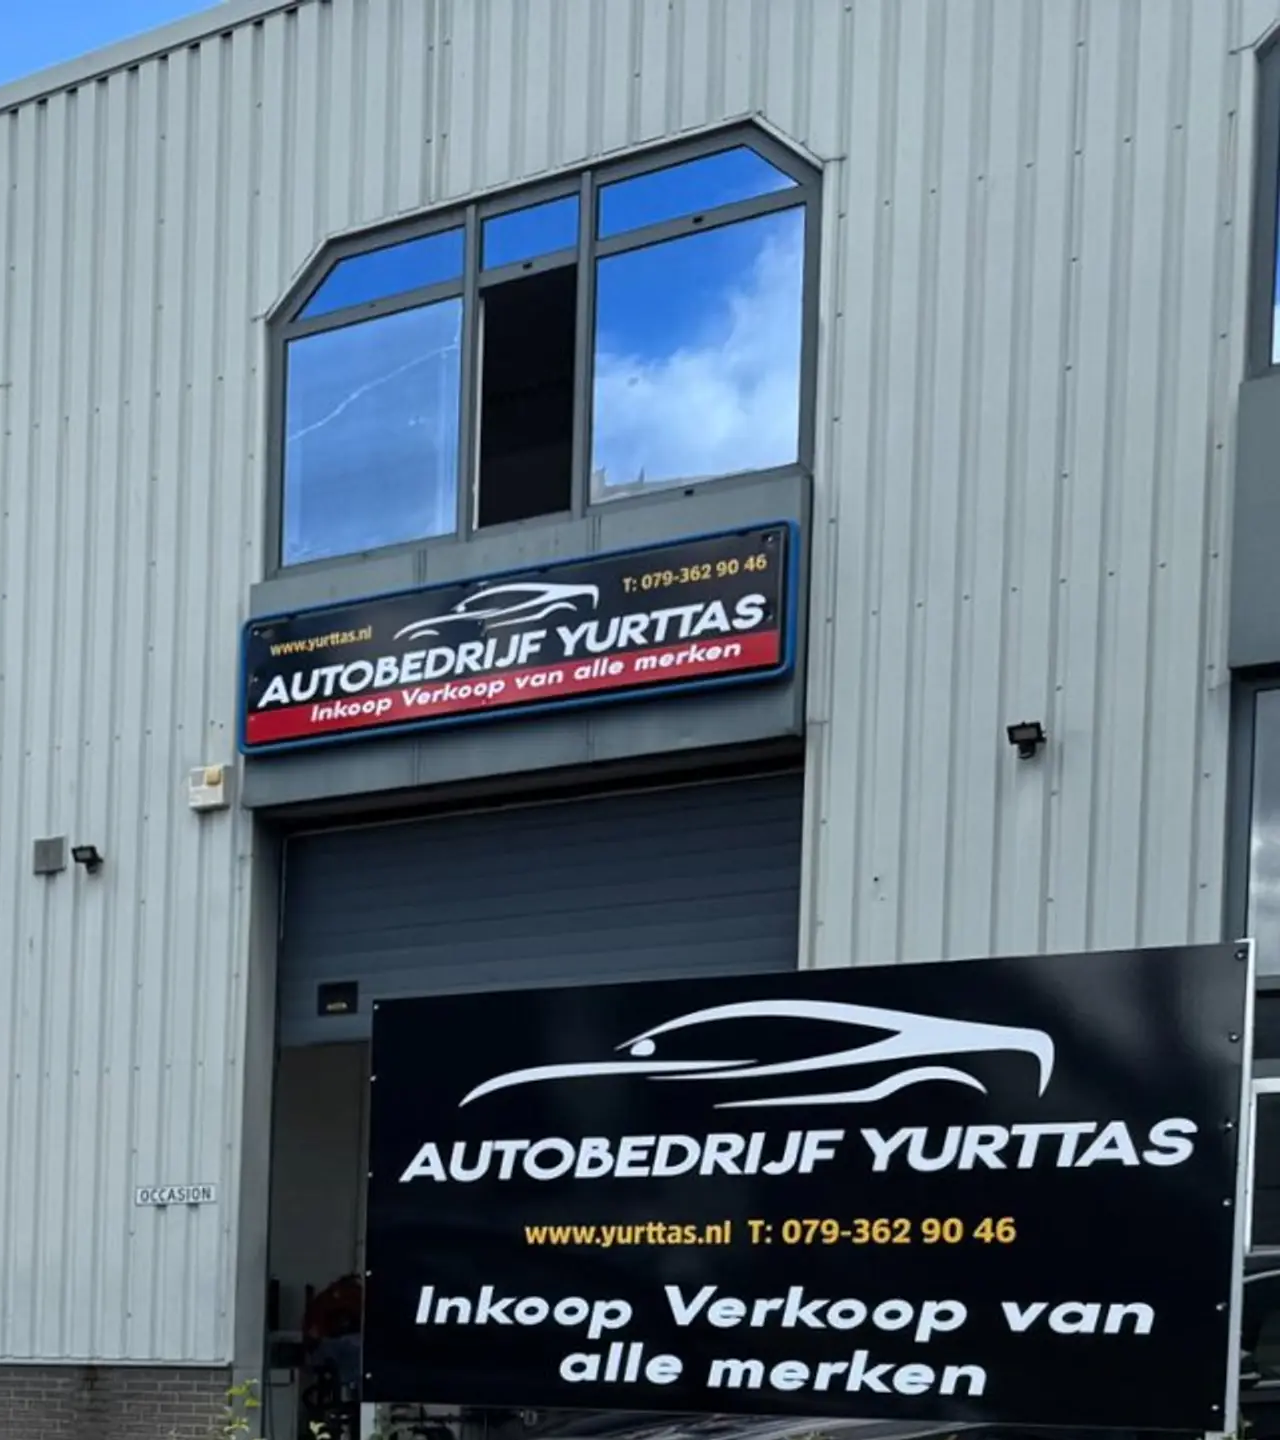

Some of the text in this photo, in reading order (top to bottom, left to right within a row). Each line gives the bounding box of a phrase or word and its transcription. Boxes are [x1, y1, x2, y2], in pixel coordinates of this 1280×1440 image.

[622, 553, 768, 593] T: 079-362 90 46
[257, 593, 767, 709] AUTOBEDRIJF YURTTAS
[270, 625, 373, 657] www.yurttas.nl
[310, 642, 742, 723] Inkoop Verkoop van alle merken
[398, 1117, 1199, 1183] AUTOBEDRIJF YURTTAS
[140, 1187, 212, 1202] OCCASION
[523, 1216, 1017, 1248] www.yurttas.nl T: 079-362 90 46
[414, 1285, 1156, 1343] Inkoop Verkoop van
[558, 1341, 988, 1397] alle merken
